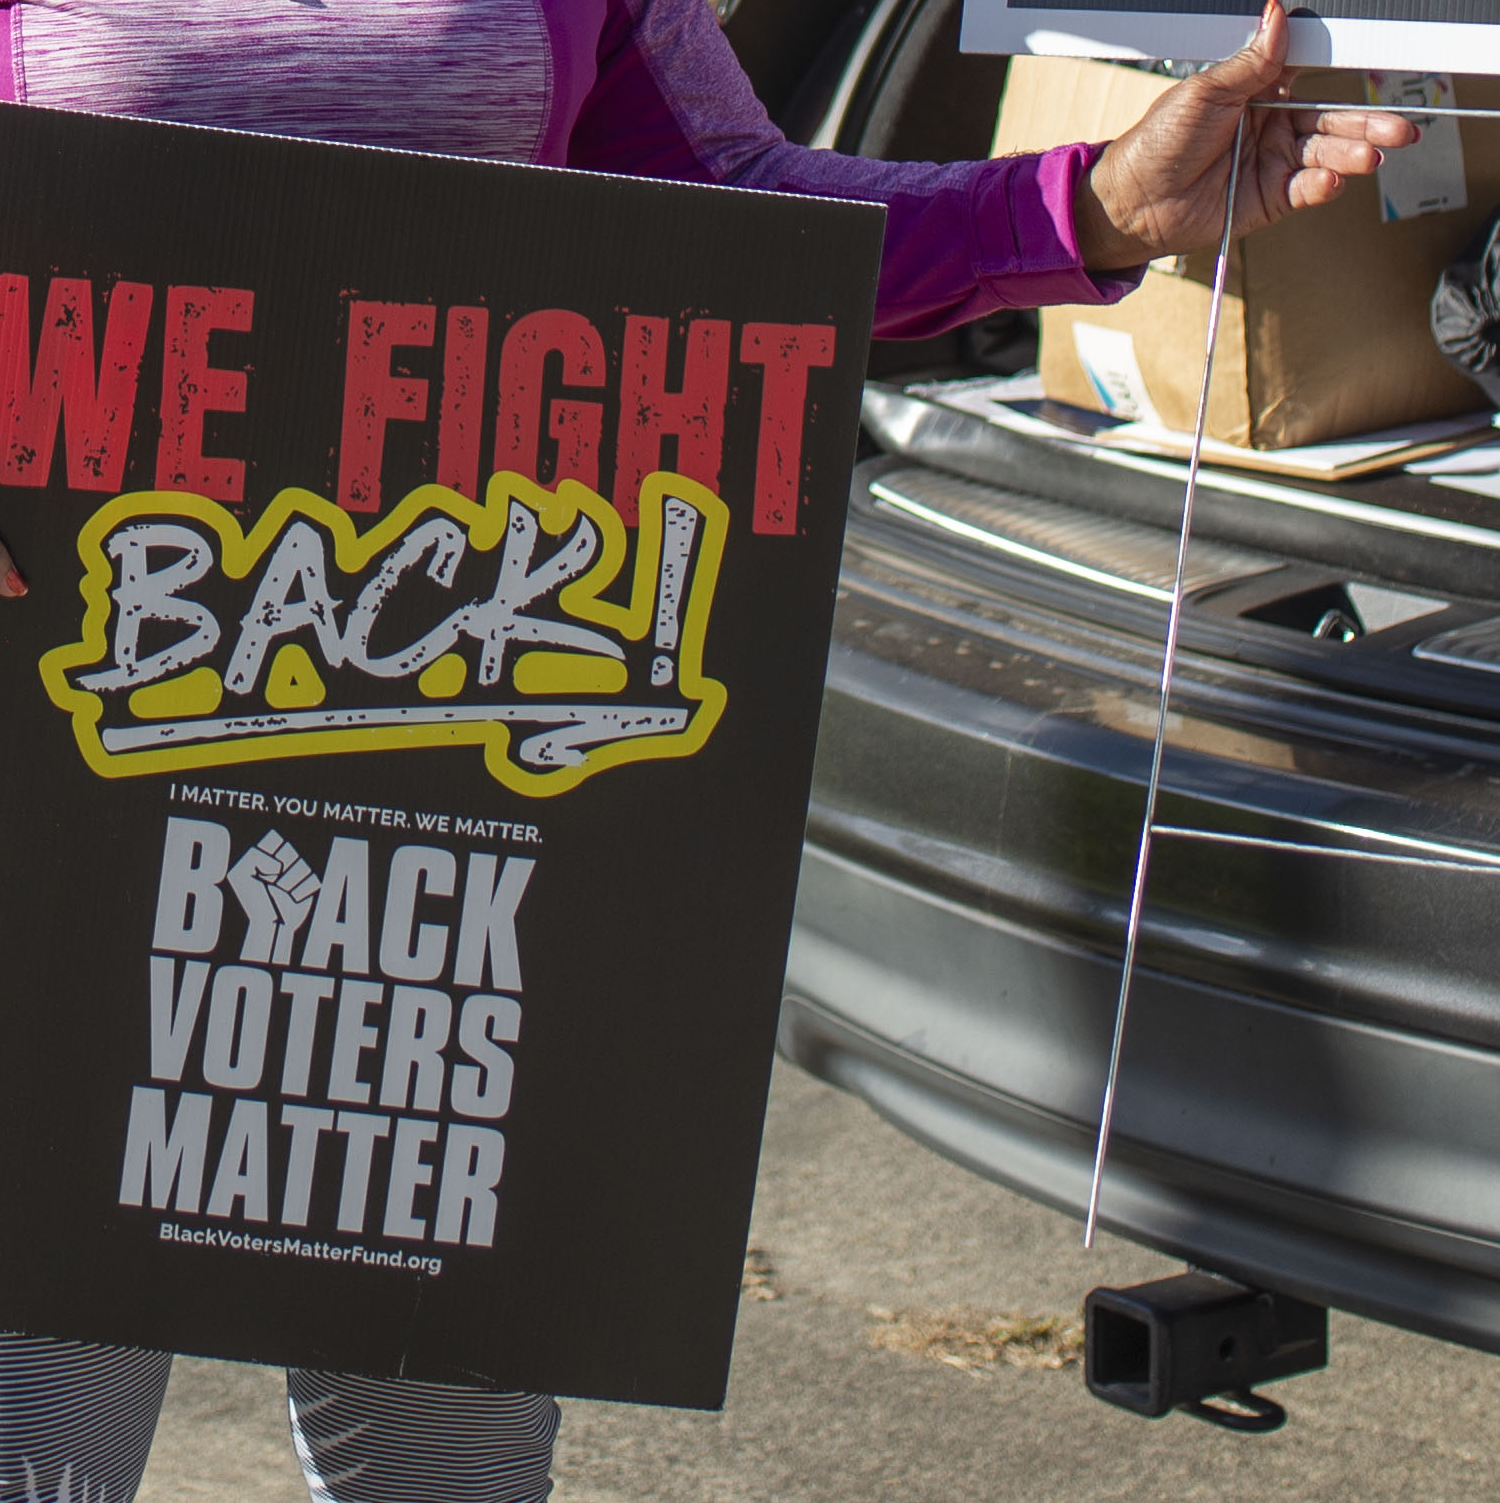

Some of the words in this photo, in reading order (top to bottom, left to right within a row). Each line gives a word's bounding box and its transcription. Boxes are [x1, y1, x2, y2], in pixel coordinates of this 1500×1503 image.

[334, 293, 837, 536] FIGHT
[74, 496, 698, 695] BACK!
[169, 783, 176, 801] I
[181, 784, 270, 813] MATTER.
[273, 796, 318, 818] YOU
[323, 801, 412, 830] MATTER.
[415, 812, 450, 834] WE
[455, 816, 544, 844] MATTER.
[151, 815, 537, 993] BACK
[149, 954, 523, 1120] VOTERS
[117, 1085, 506, 1248] MATTER
[158, 1222, 443, 1276] BlackVotersMatterFund.org
